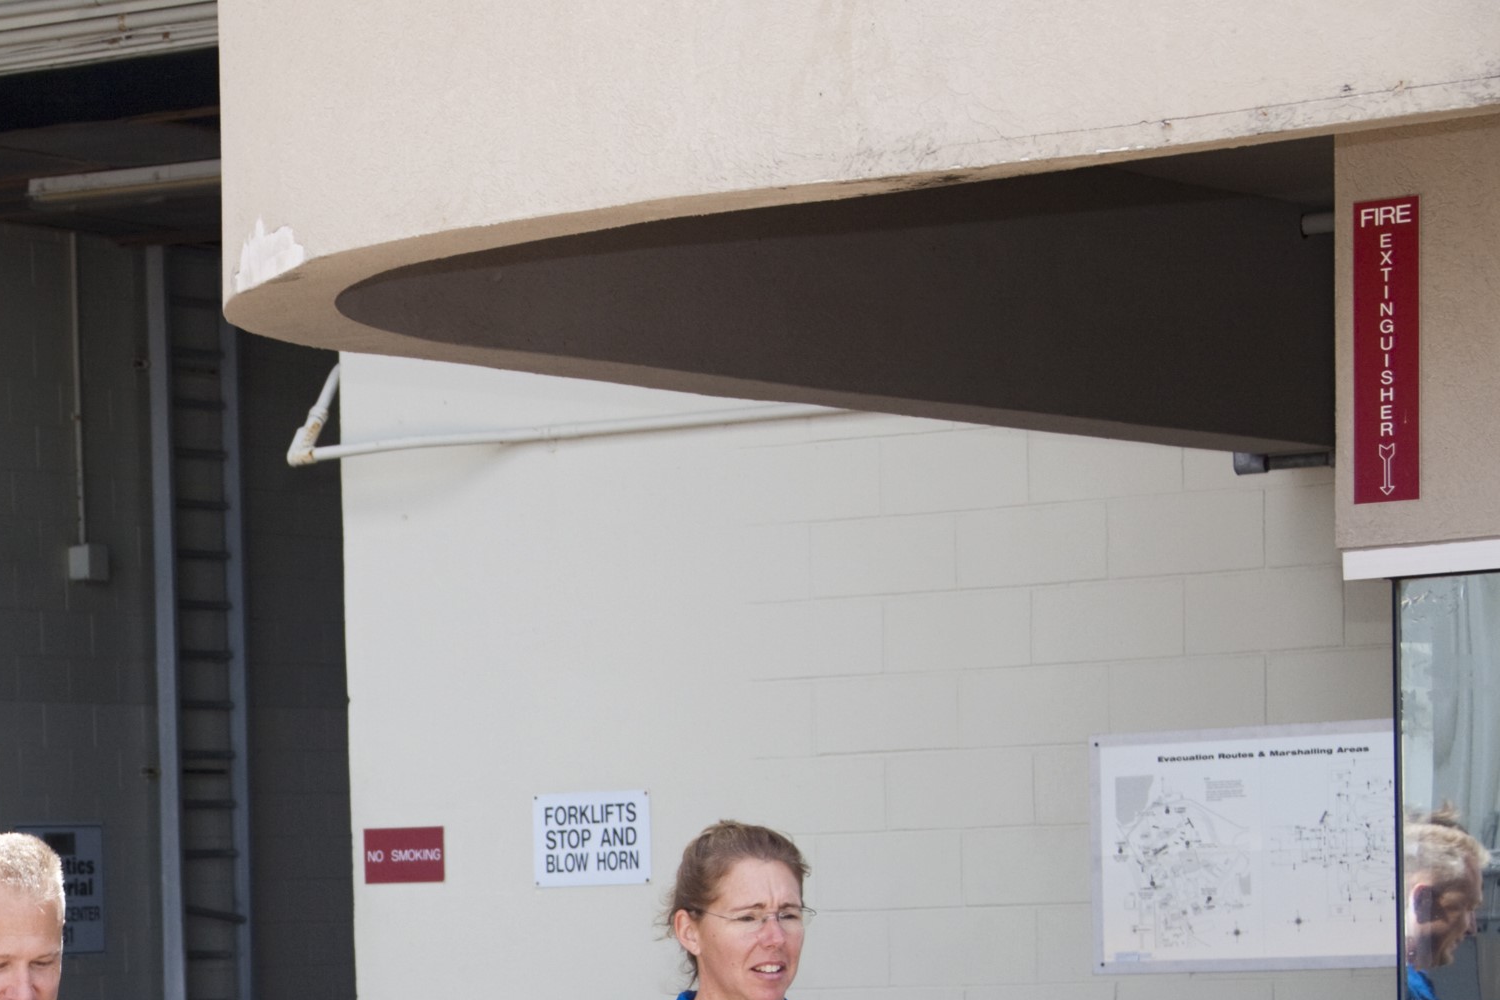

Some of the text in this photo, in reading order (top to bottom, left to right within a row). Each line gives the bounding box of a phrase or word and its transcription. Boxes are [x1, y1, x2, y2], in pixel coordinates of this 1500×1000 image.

[1360, 204, 1412, 228] FIRE
[1379, 233, 1394, 437] EXTINGUISHER
[1157, 754, 1215, 763] Evacuation
[1218, 752, 1254, 760] Routes
[1269, 748, 1333, 757] Marshalling
[1337, 746, 1370, 754] Areas
[545, 802, 637, 826] FORKLIFTS
[545, 826, 637, 850] STOP AND
[66, 857, 95, 875] tics
[367, 848, 441, 863] NO SMOKING
[545, 850, 640, 873] BLOW HORN
